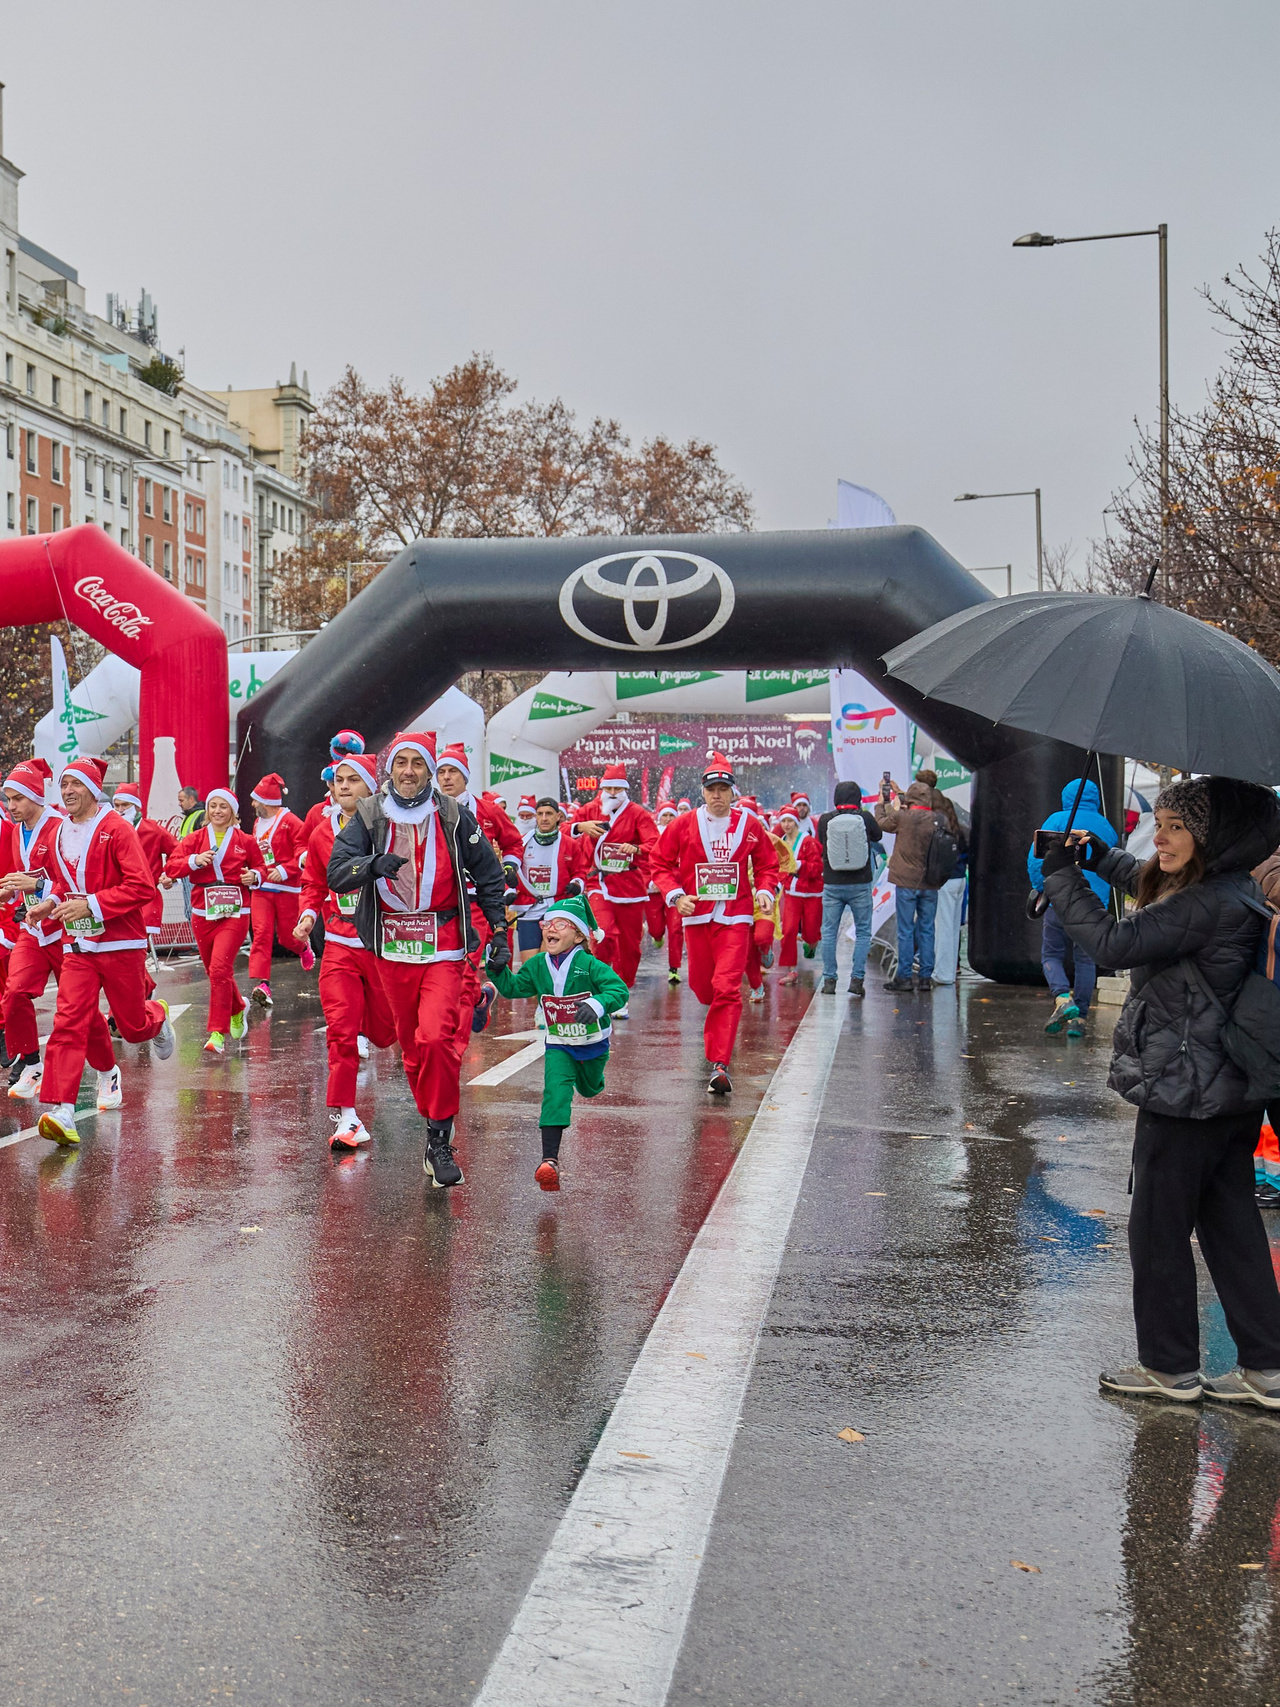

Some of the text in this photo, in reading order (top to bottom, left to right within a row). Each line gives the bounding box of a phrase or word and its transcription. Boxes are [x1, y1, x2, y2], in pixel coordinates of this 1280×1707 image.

[74, 576, 154, 640] Coca-Cola
[791, 671, 830, 684] Inglé
[574, 736, 656, 755] Papá Noel
[707, 733, 792, 753] Papá Noel
[706, 884, 729, 894] 3651
[395, 940, 423, 955] 9410
[557, 1023, 588, 1037] 9408
